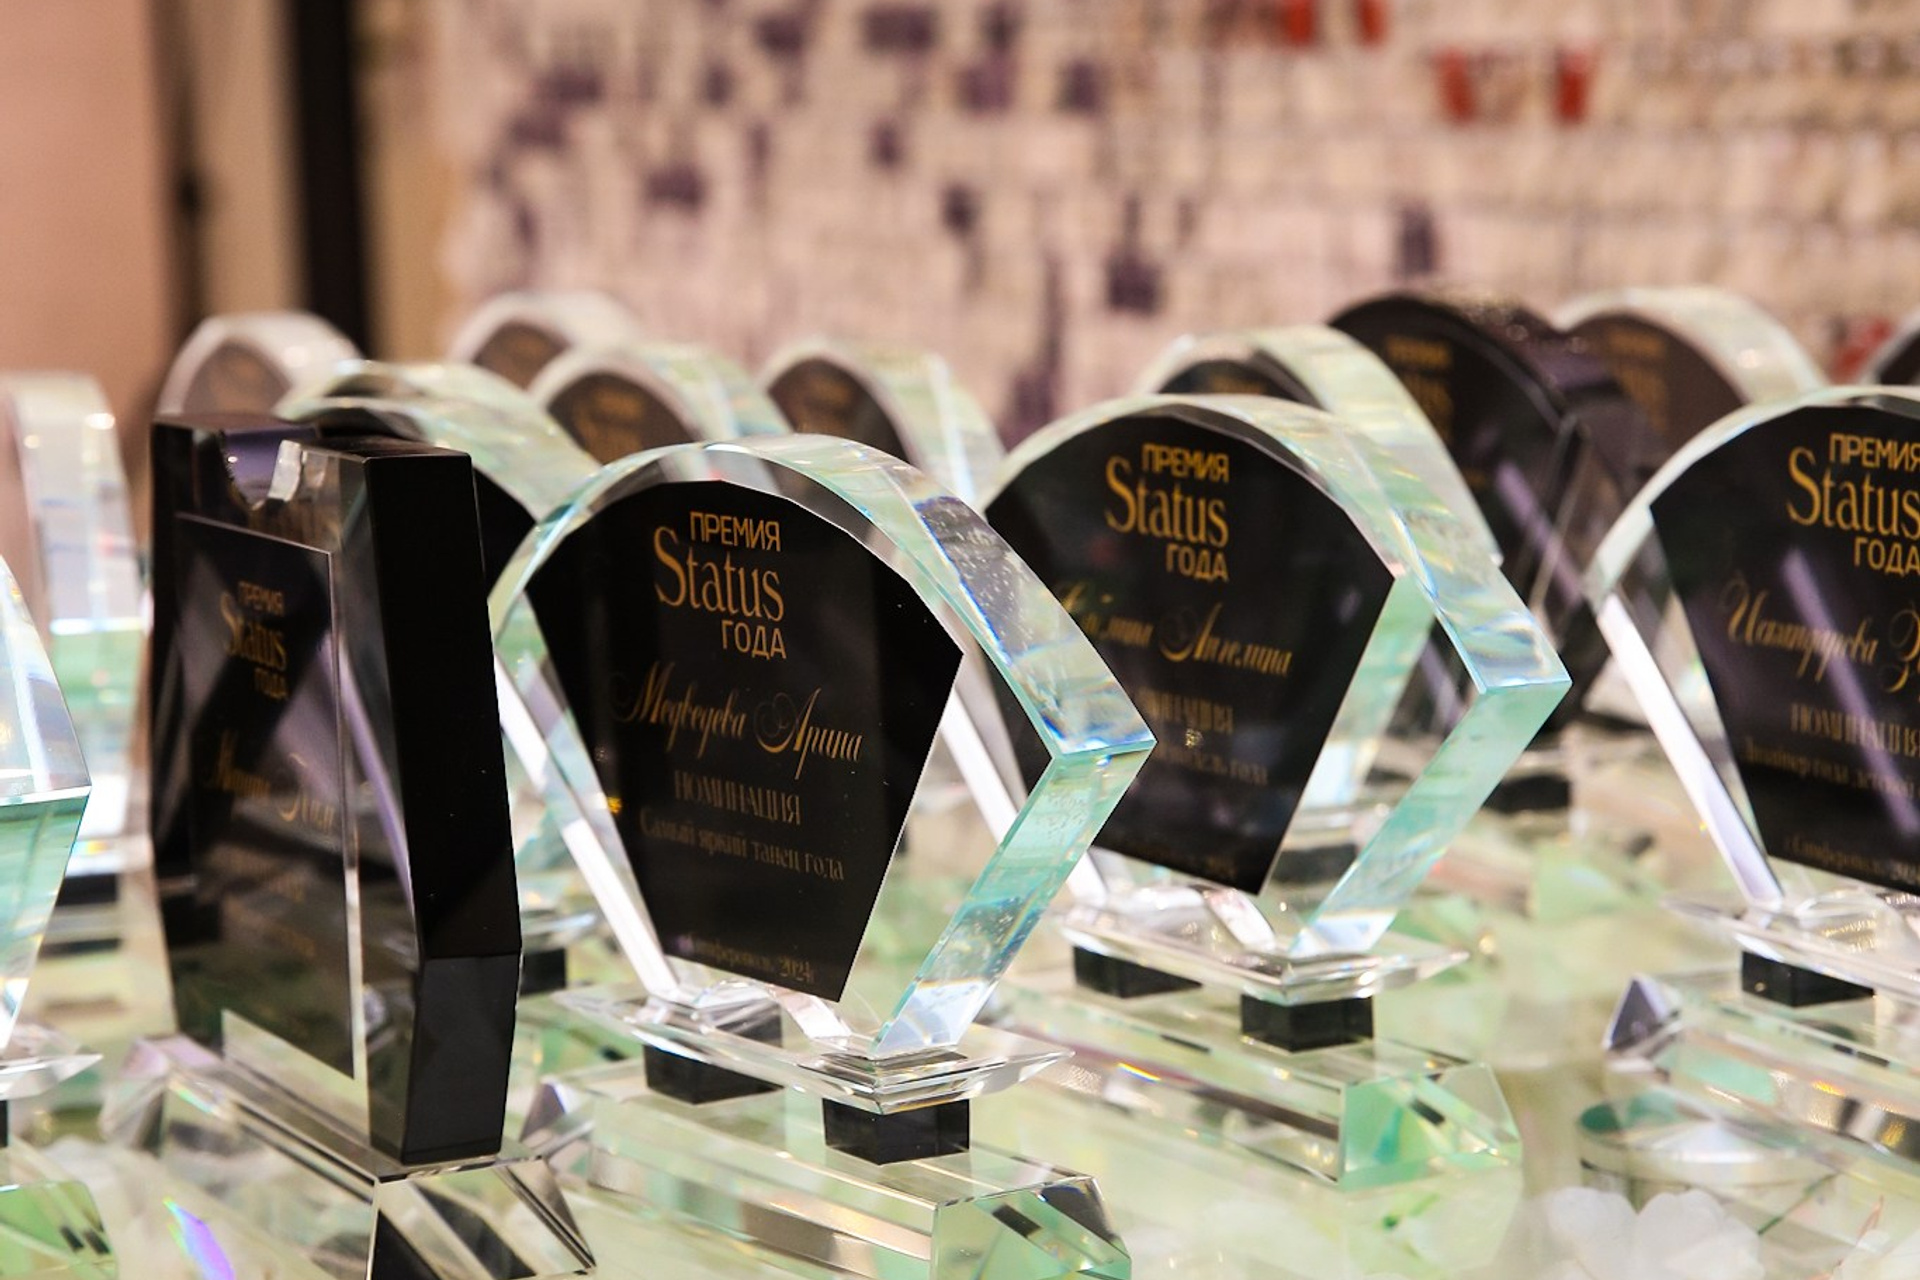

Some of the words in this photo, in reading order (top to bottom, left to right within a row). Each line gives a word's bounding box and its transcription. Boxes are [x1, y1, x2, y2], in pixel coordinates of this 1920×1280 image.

[1141, 442, 1230, 483] ПРЕМИЯ
[1829, 432, 1920, 473] ПРЕМИЯ
[1104, 454, 1230, 549] Status
[1785, 445, 1920, 541] Status
[690, 511, 782, 552] ПРЕМИЯ
[652, 526, 784, 622] Status
[1165, 543, 1230, 582] ГОДА
[1853, 536, 1920, 578] ГОДА
[722, 619, 787, 659] ГОДА
[674, 769, 801, 826] НОМИНАЦИЯ
[751, 840, 800, 873] танец
[804, 852, 845, 881] года
